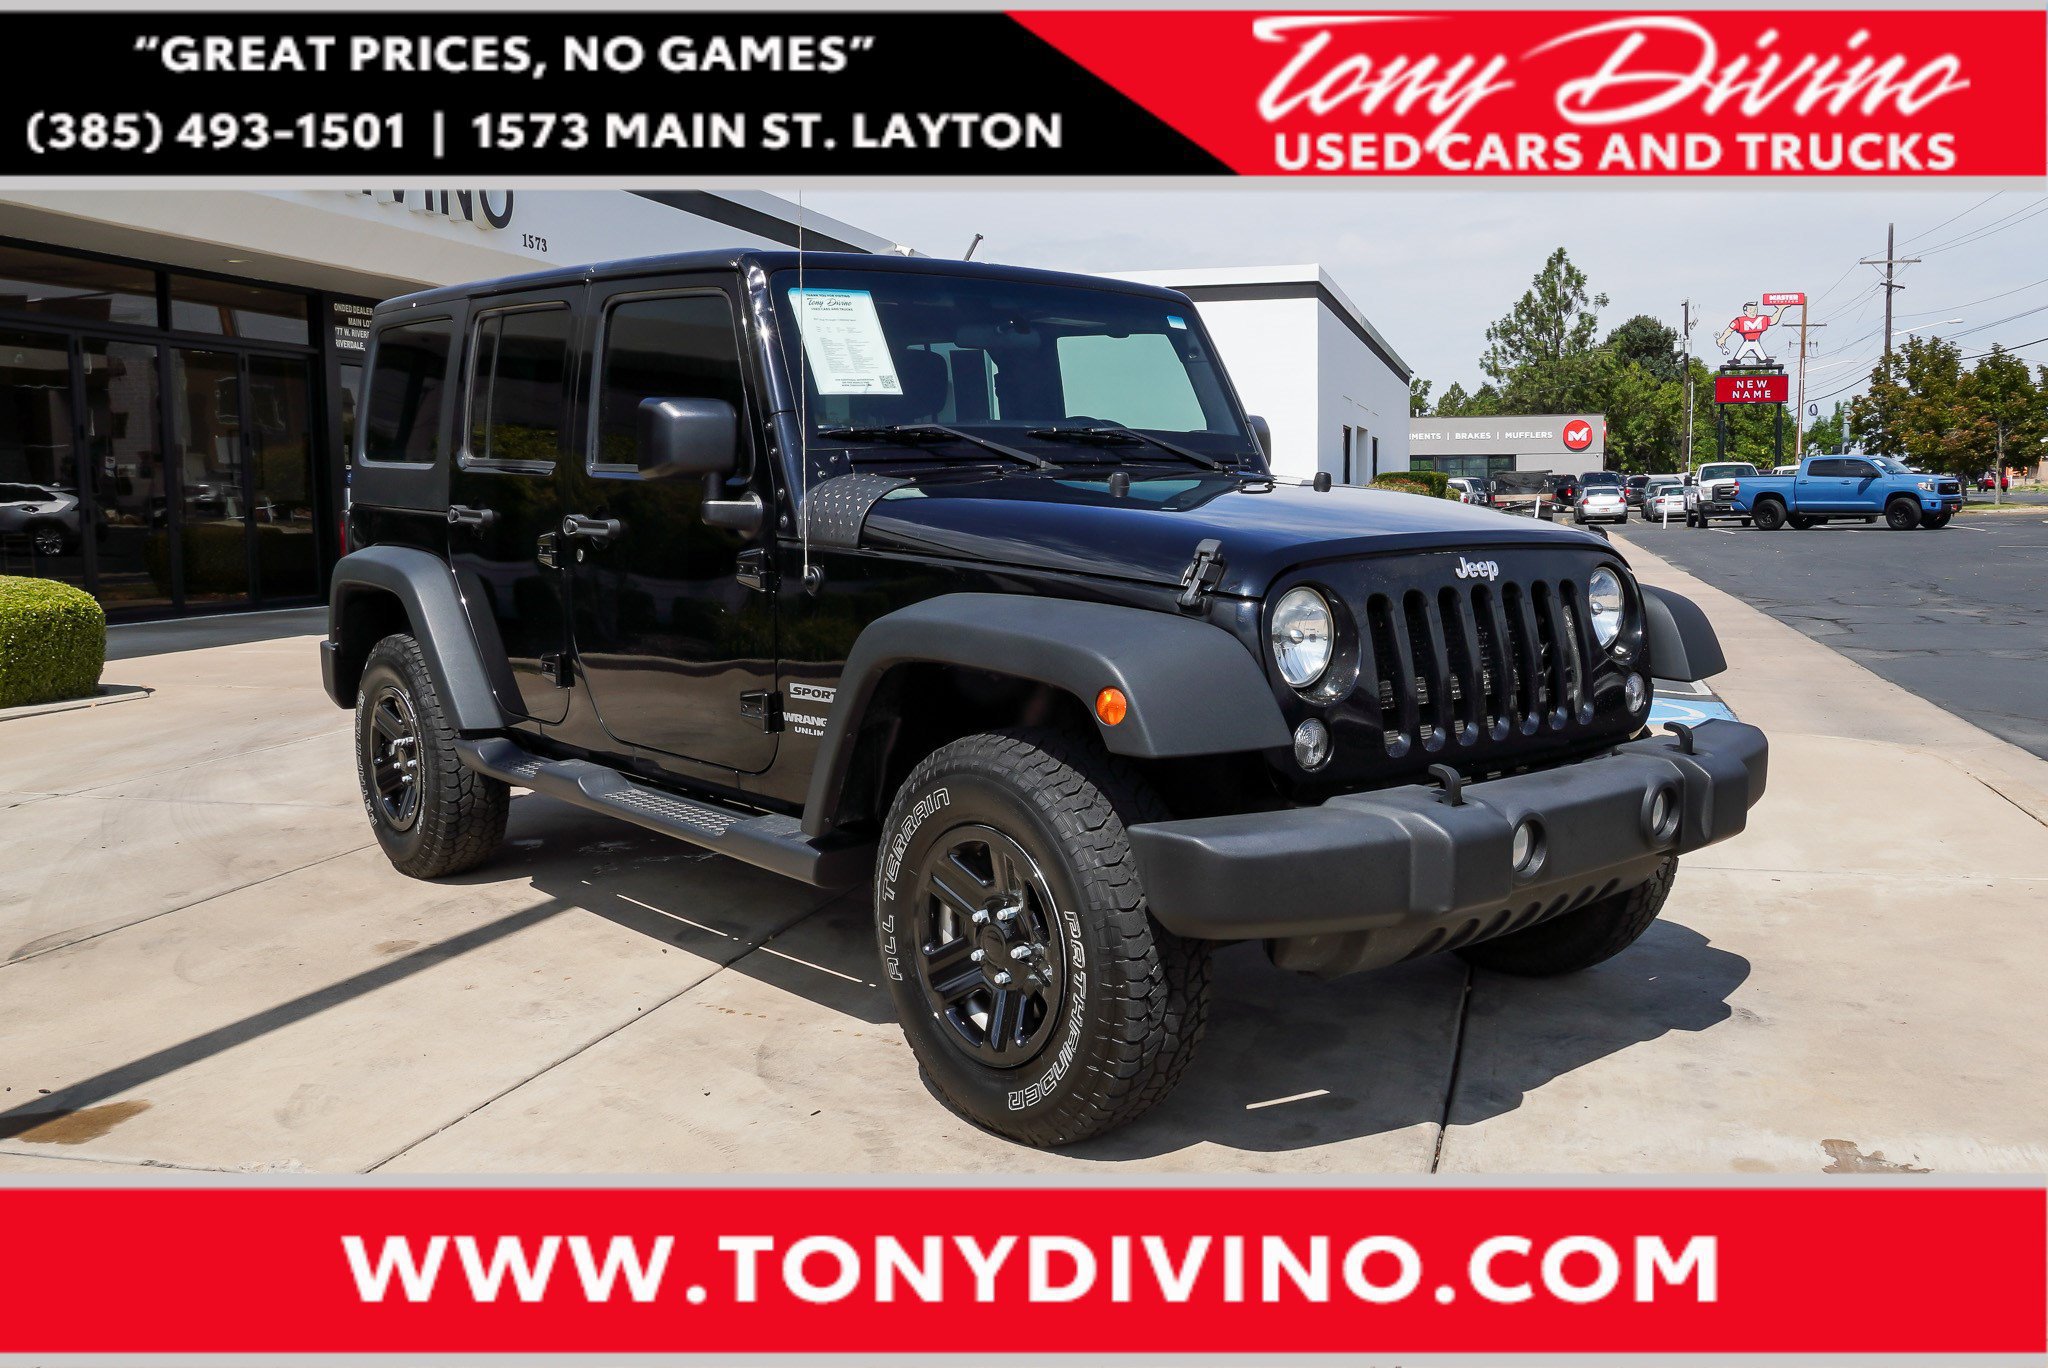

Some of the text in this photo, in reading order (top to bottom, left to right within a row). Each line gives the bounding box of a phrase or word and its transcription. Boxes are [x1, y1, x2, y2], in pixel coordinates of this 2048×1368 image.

[521, 233, 548, 253] 1573
[807, 297, 853, 308] Tony Divino
[347, 317, 362, 327] MAIN
[1736, 379, 1768, 389] NEW
[1732, 390, 1772, 399] NAME
[1409, 433, 1442, 441] MENTS
[1455, 432, 1492, 440] BRAKES
[1504, 431, 1553, 440] MUFFLERS
[1455, 556, 1499, 582] Jeep
[882, 787, 951, 982] ALL TERRAIN
[1007, 910, 1087, 1112] PATHFINDER
